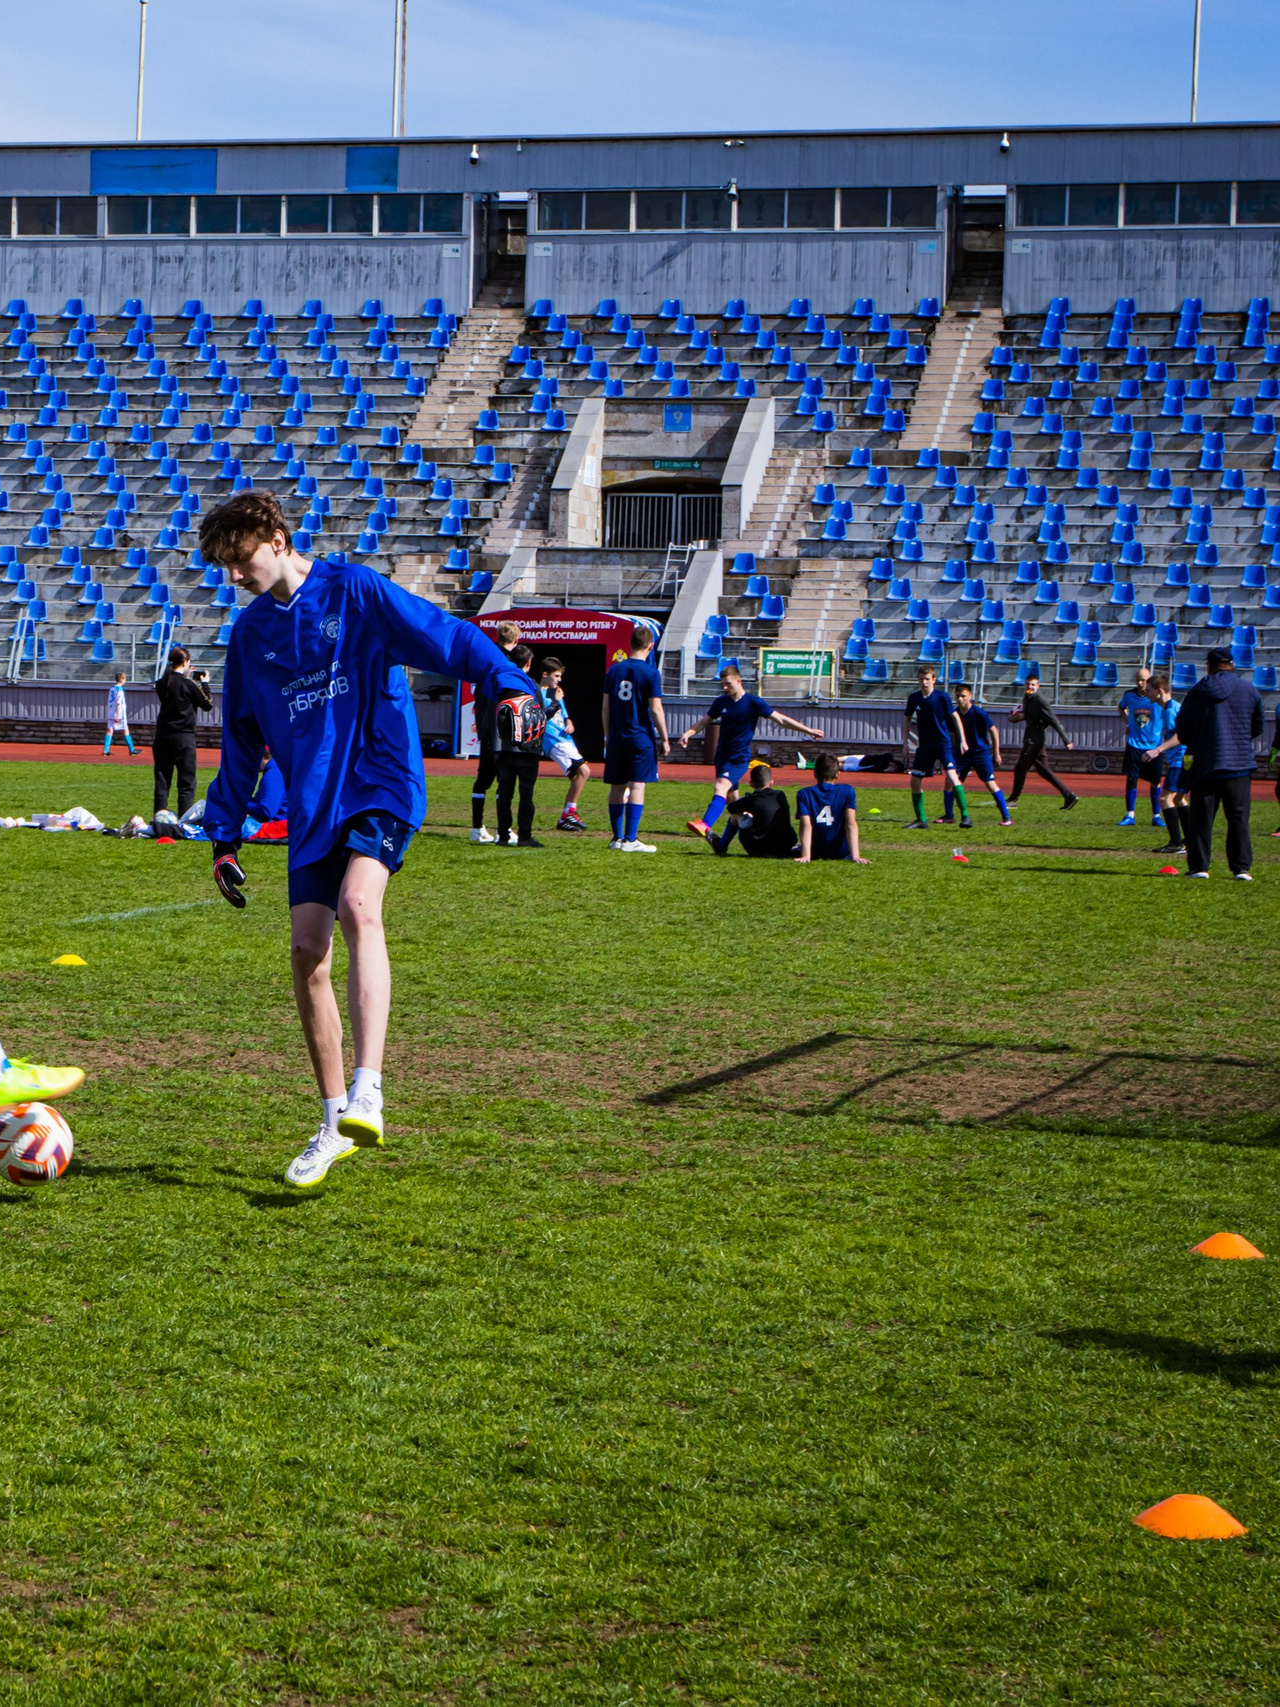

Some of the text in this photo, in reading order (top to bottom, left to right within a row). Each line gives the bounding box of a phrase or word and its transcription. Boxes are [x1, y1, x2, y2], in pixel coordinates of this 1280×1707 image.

[673, 411, 683, 424] 9
[548, 621, 574, 629] ТУРНИР
[576, 621, 588, 629] ПО
[590, 621, 617, 629] РЕГБИ-7
[549, 631, 598, 640] РОСГВАРДИИ
[109, 690, 115, 702] 3
[618, 680, 633, 701] 8
[815, 805, 835, 826] 4
